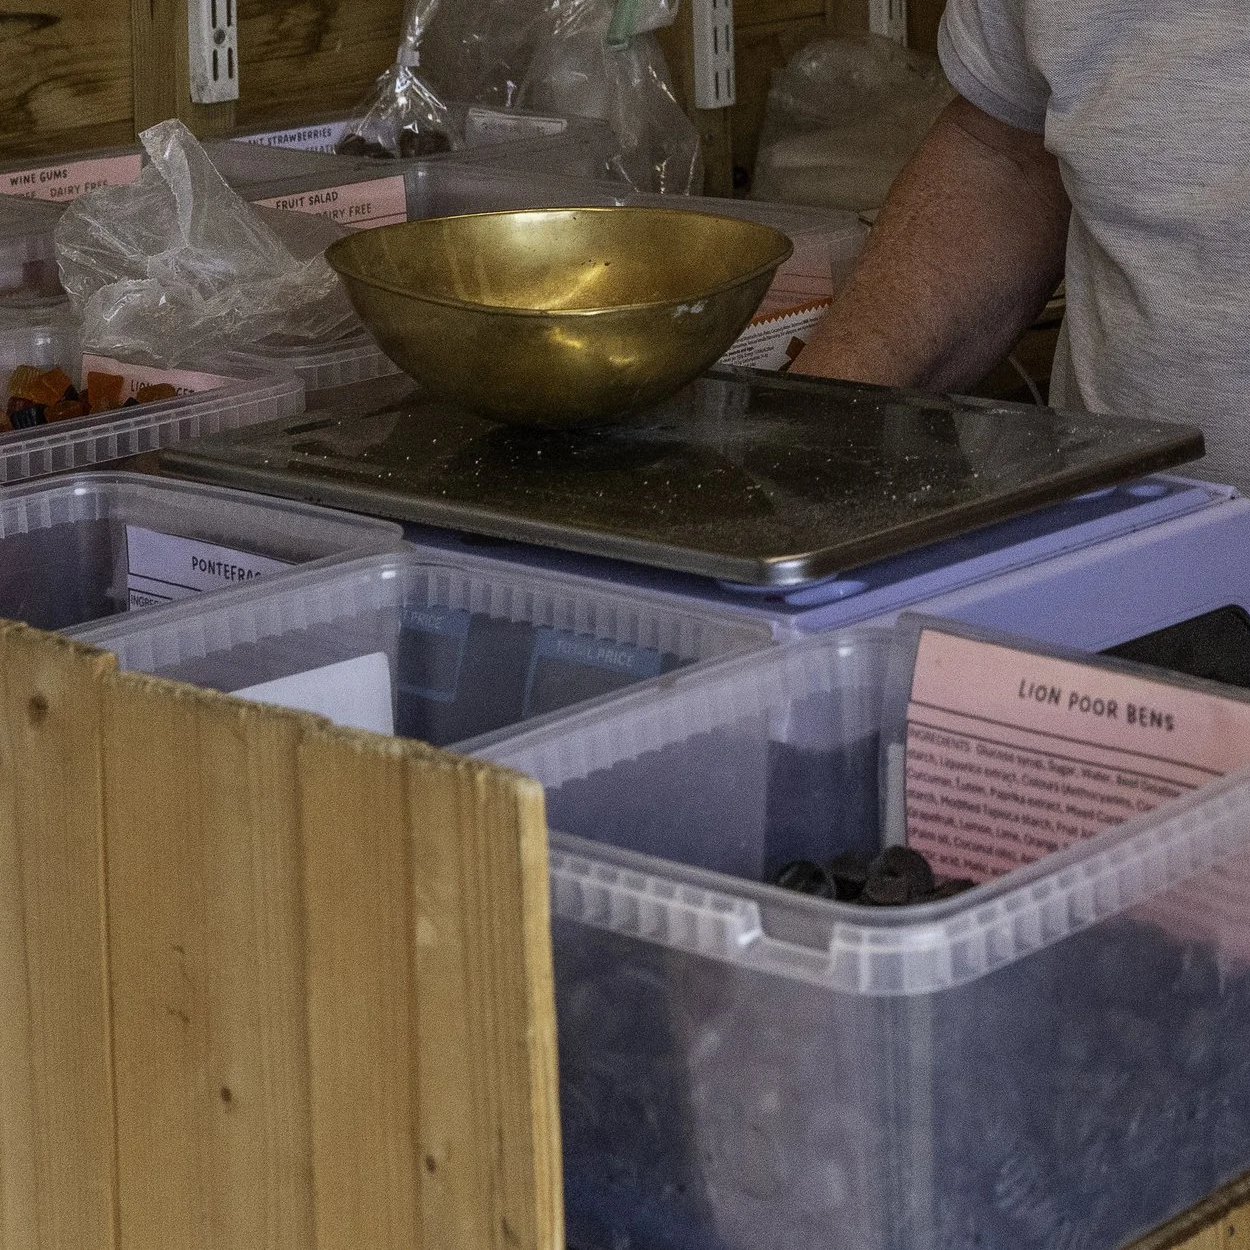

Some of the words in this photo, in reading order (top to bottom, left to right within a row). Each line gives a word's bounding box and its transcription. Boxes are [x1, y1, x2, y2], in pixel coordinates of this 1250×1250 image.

[268, 128, 332, 147] STRAWBERRIES
[10, 174, 36, 186] WINE
[40, 170, 68, 183] GUMS
[50, 184, 81, 198] DAIRY
[276, 197, 304, 210] FRUIT
[308, 191, 339, 206] SALAD
[349, 203, 372, 217] FREE
[596, 647, 635, 669] PRICE
[1018, 678, 1062, 706] LION
[1068, 690, 1119, 719] POOR
[1126, 702, 1175, 732] BENS
